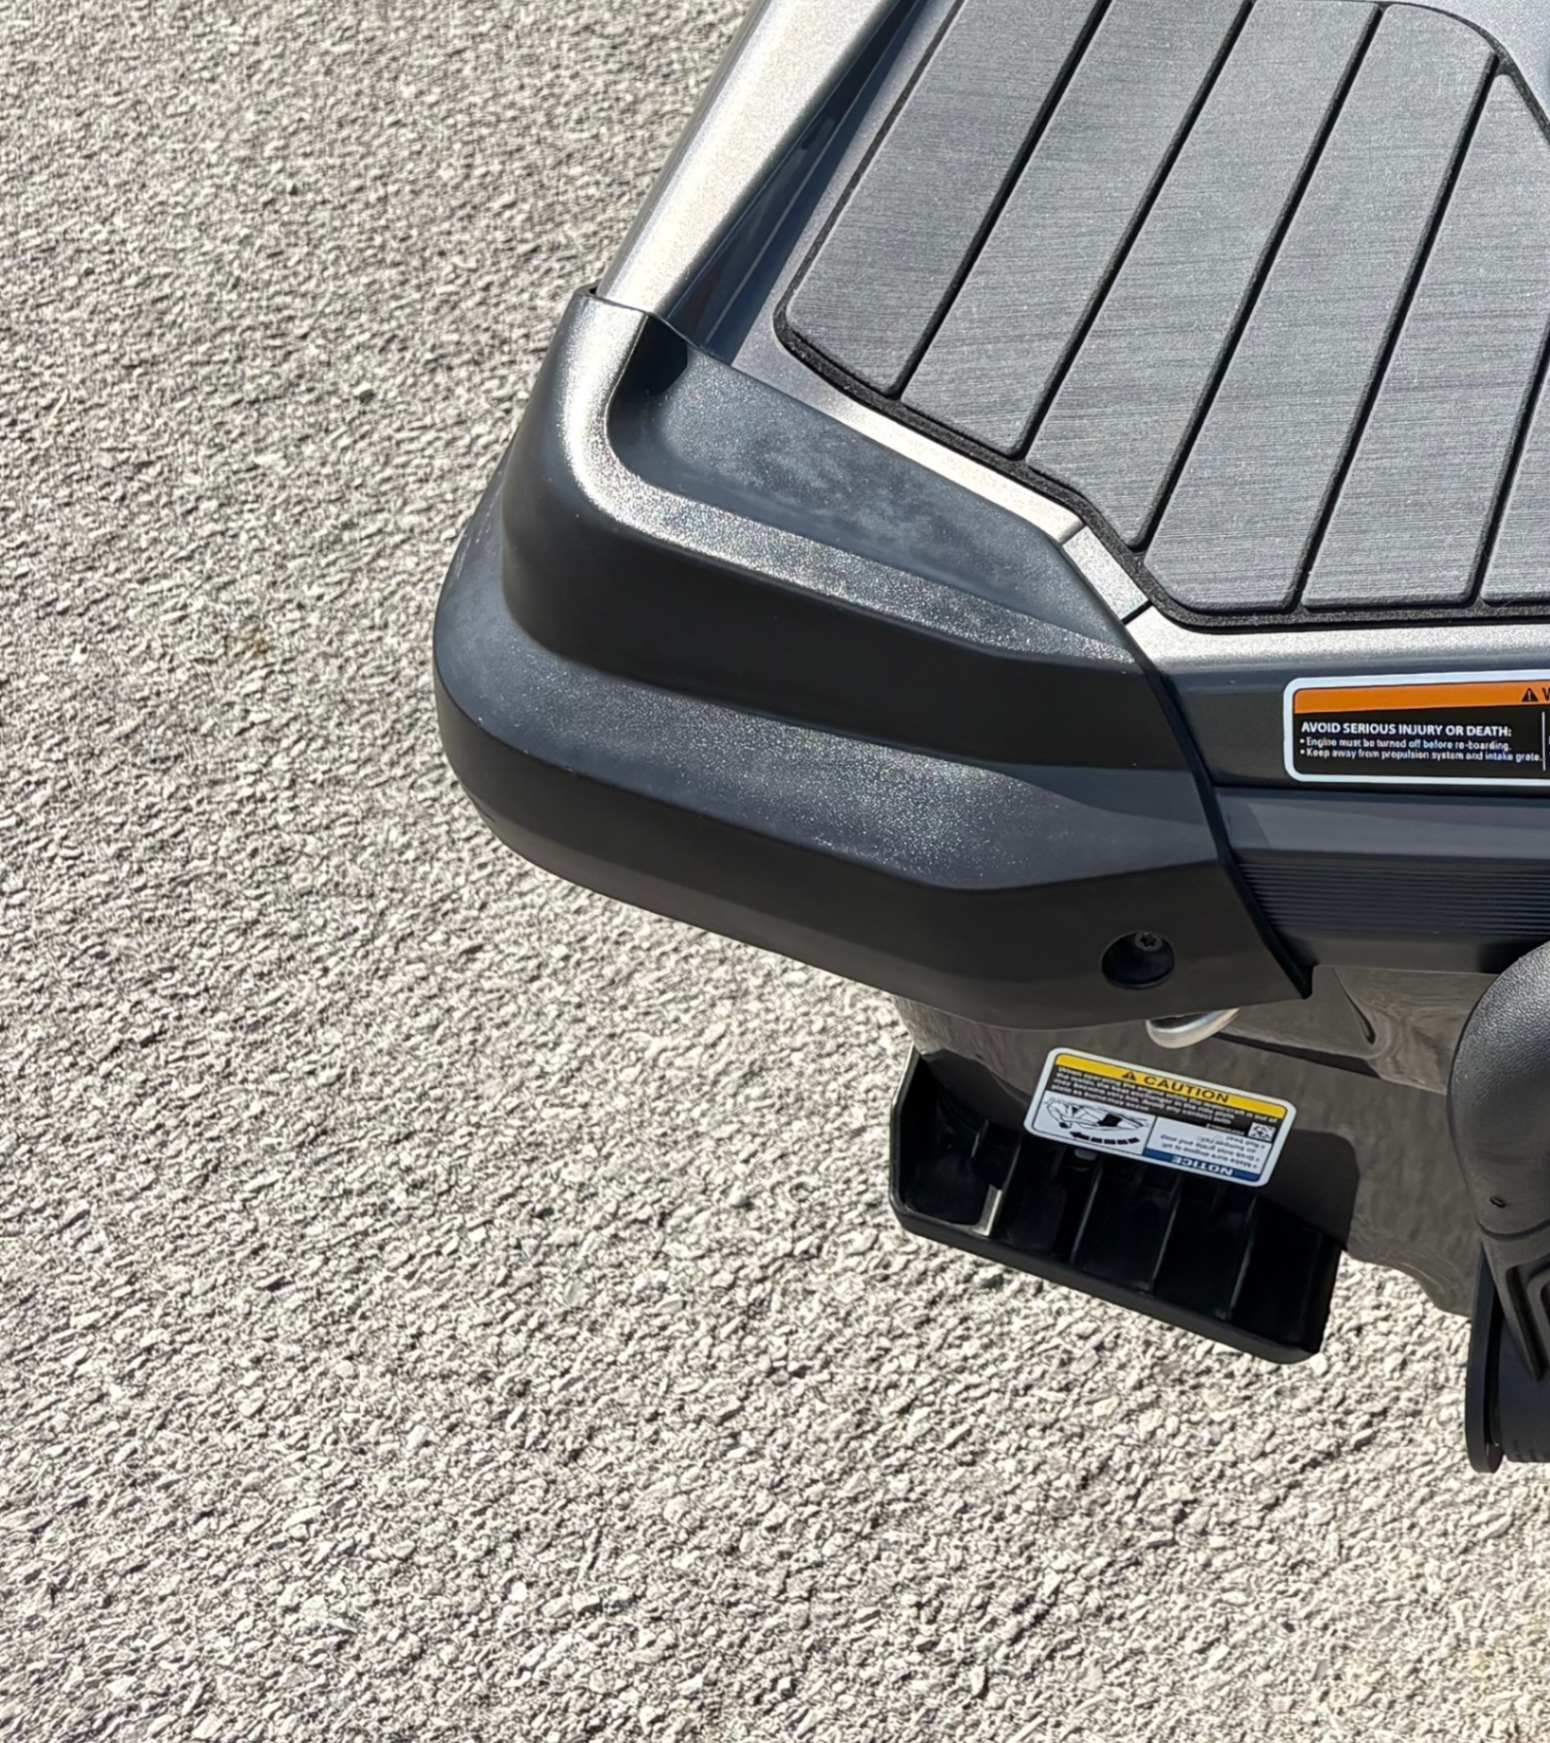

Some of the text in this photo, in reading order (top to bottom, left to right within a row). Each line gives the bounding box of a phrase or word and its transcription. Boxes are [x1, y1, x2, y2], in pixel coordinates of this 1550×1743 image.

[1301, 722, 1512, 737] AVOID SERIOUS INJURY OR DEATH:
[1423, 740, 1452, 749] before
[1143, 1073, 1230, 1104] CAUTION
[1172, 1157, 1234, 1176] NOTICE
